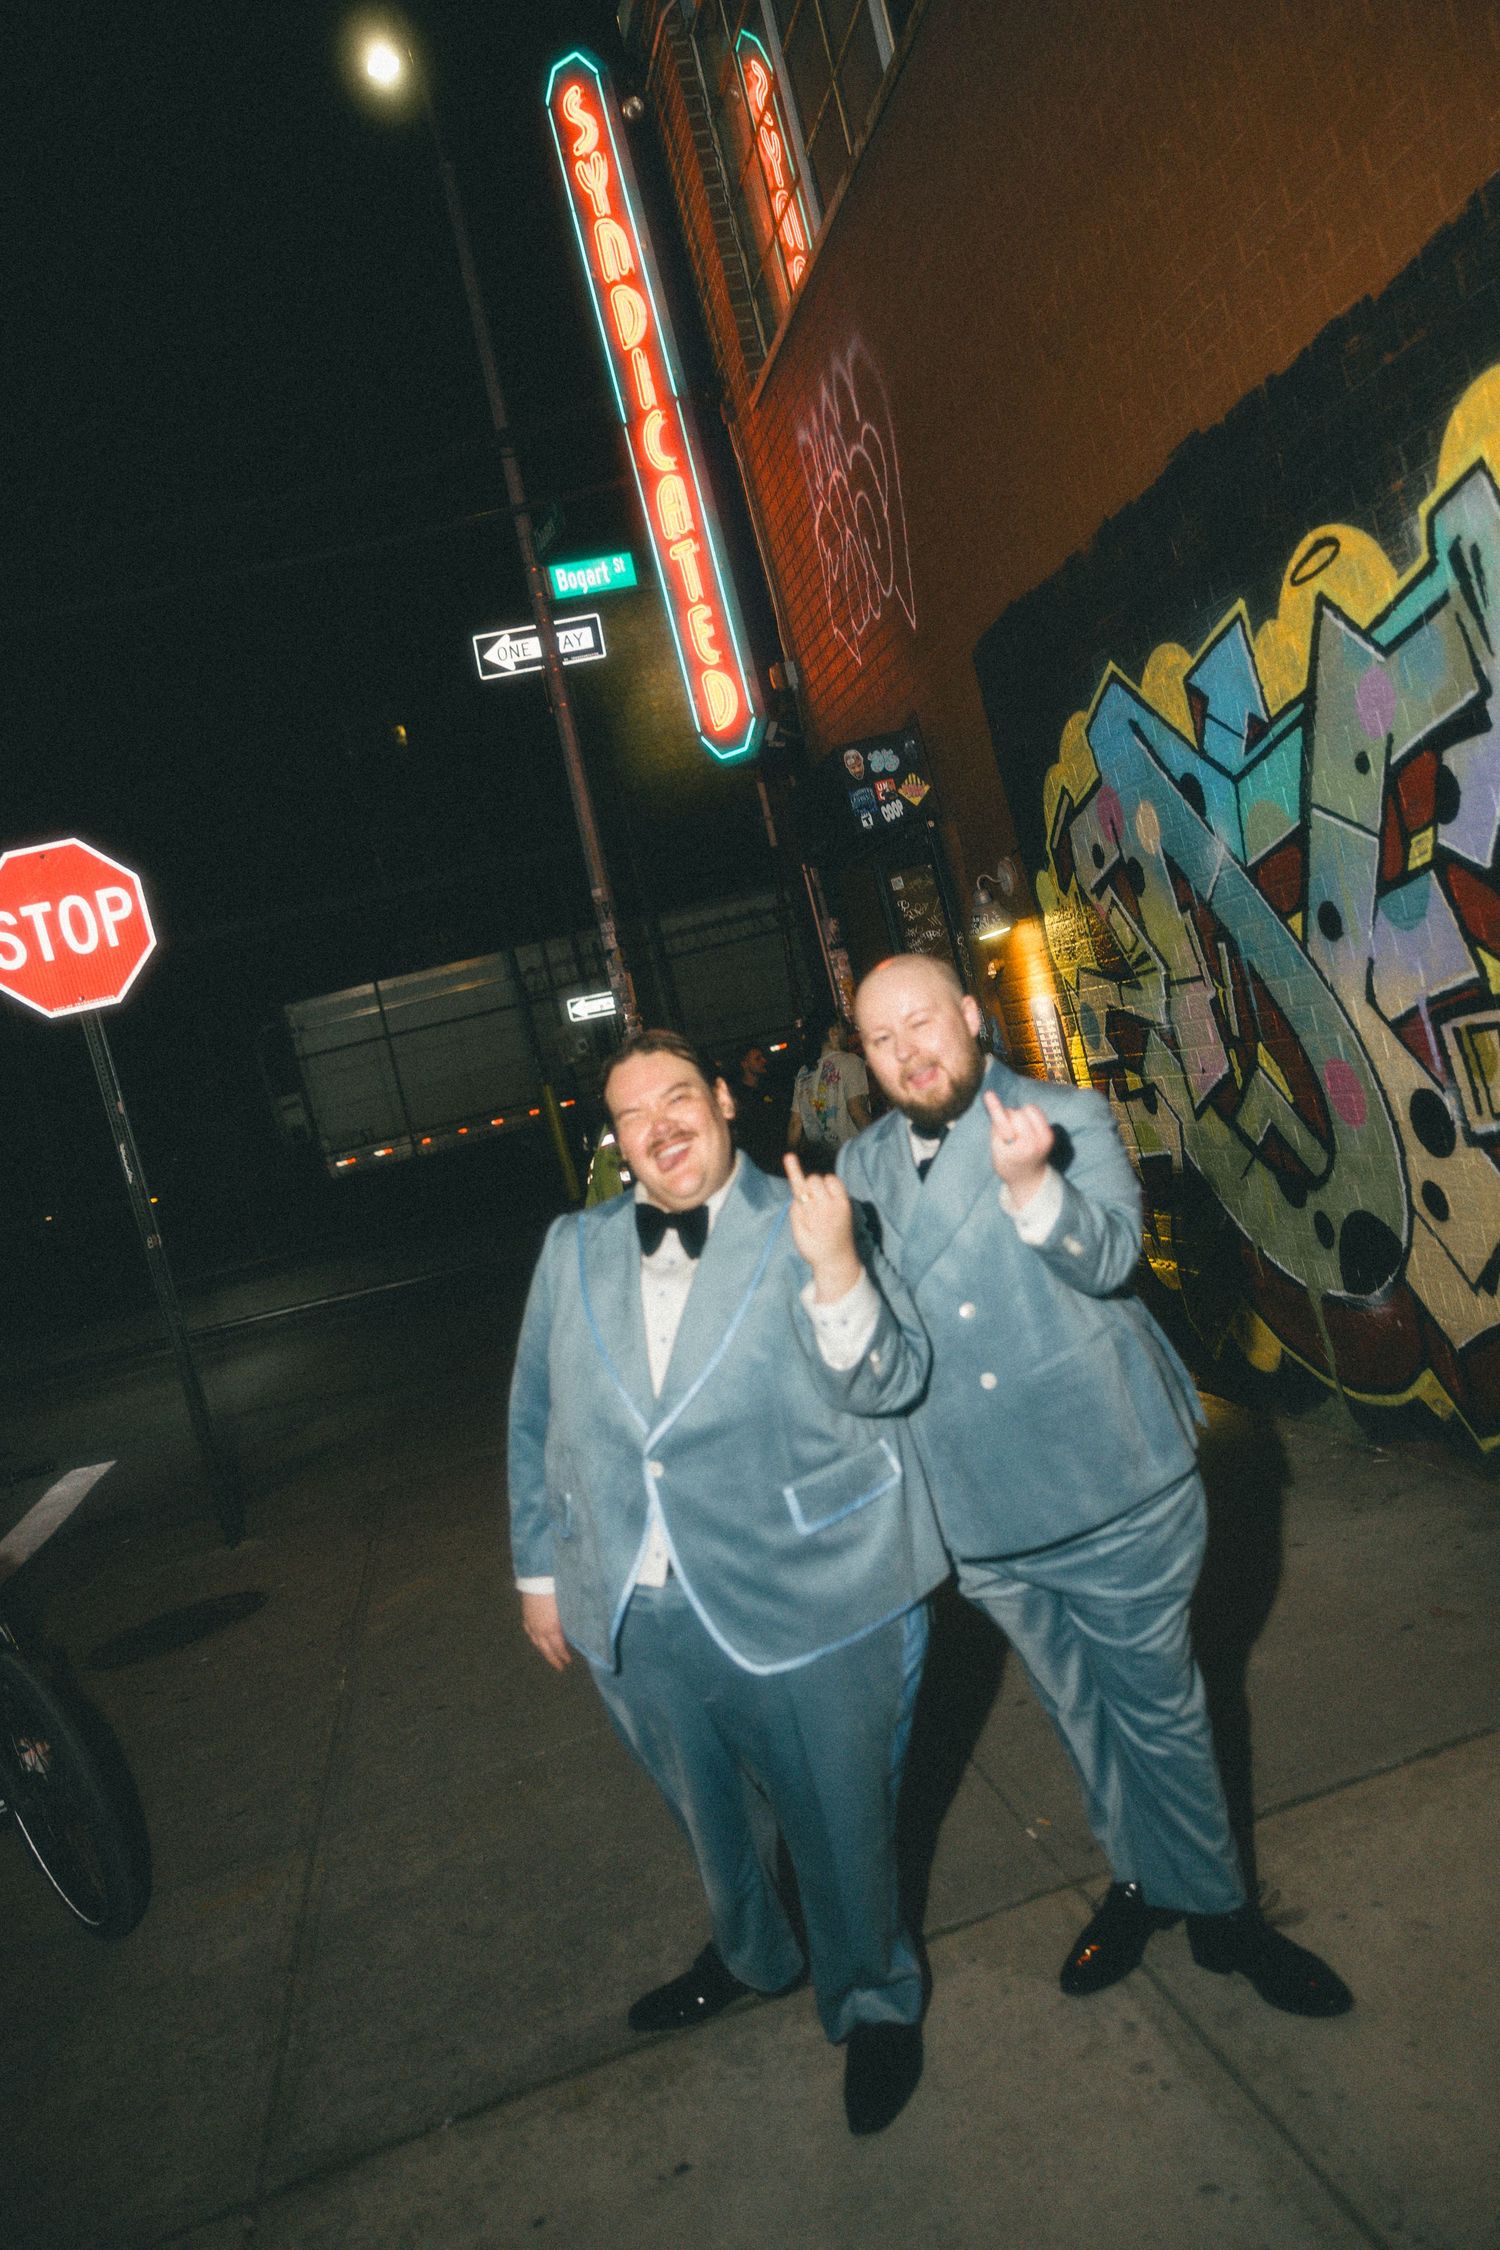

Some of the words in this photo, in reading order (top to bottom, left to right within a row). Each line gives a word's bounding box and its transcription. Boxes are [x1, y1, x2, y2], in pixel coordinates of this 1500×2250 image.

[563, 84, 738, 731] SYNDICATED
[555, 561, 611, 594] Bogart
[612, 556, 626, 573] St
[497, 641, 532, 662] ONE
[562, 631, 584, 649] AY
[0, 886, 132, 971] STOP
